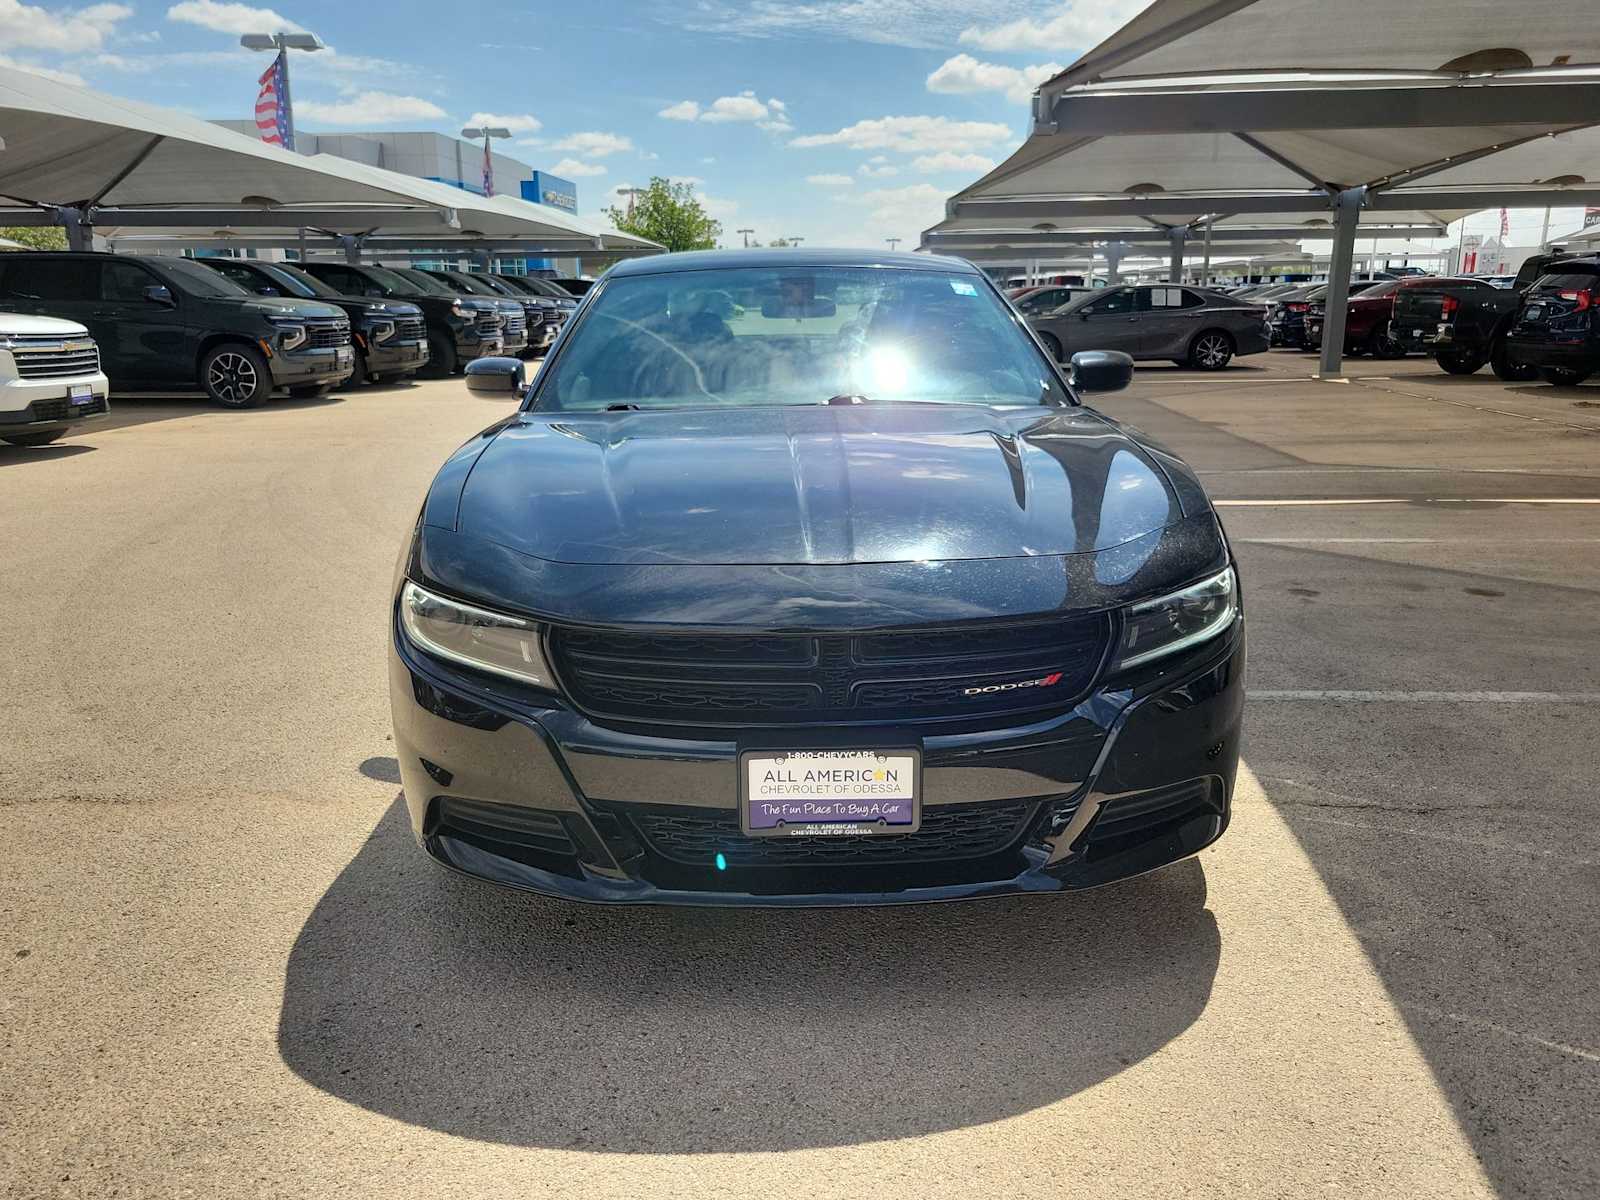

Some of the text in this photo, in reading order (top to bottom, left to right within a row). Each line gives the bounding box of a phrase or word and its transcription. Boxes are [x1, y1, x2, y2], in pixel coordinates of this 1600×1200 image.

[764, 769, 898, 783] ALL AMERICN
[760, 783, 901, 795] CHEVROLET OF ODESSA
[761, 802, 900, 817] The Fun Place To Buy A Car
